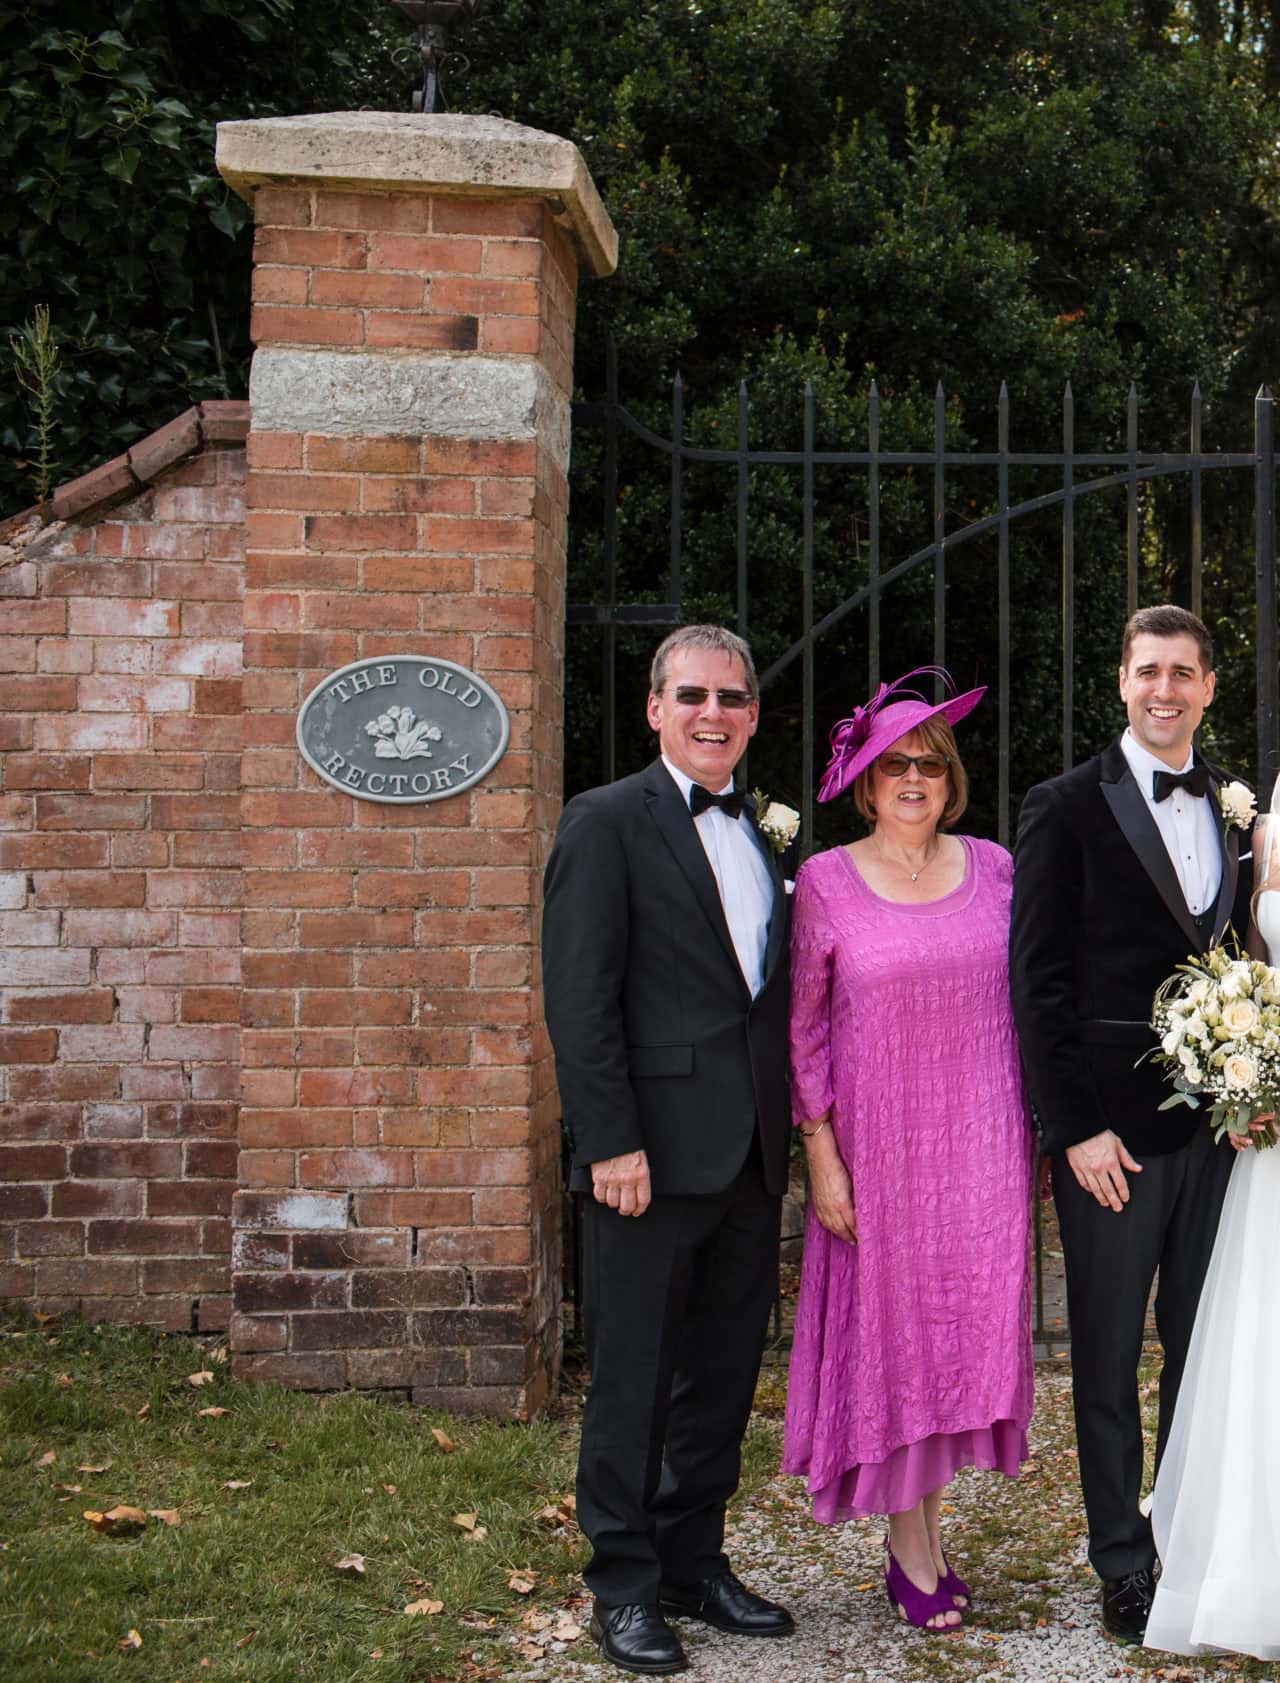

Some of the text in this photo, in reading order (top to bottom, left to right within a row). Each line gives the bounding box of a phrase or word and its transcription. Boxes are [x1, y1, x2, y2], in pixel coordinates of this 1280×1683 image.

[329, 664, 482, 708] THE OLD
[322, 750, 474, 794] RECTORY
